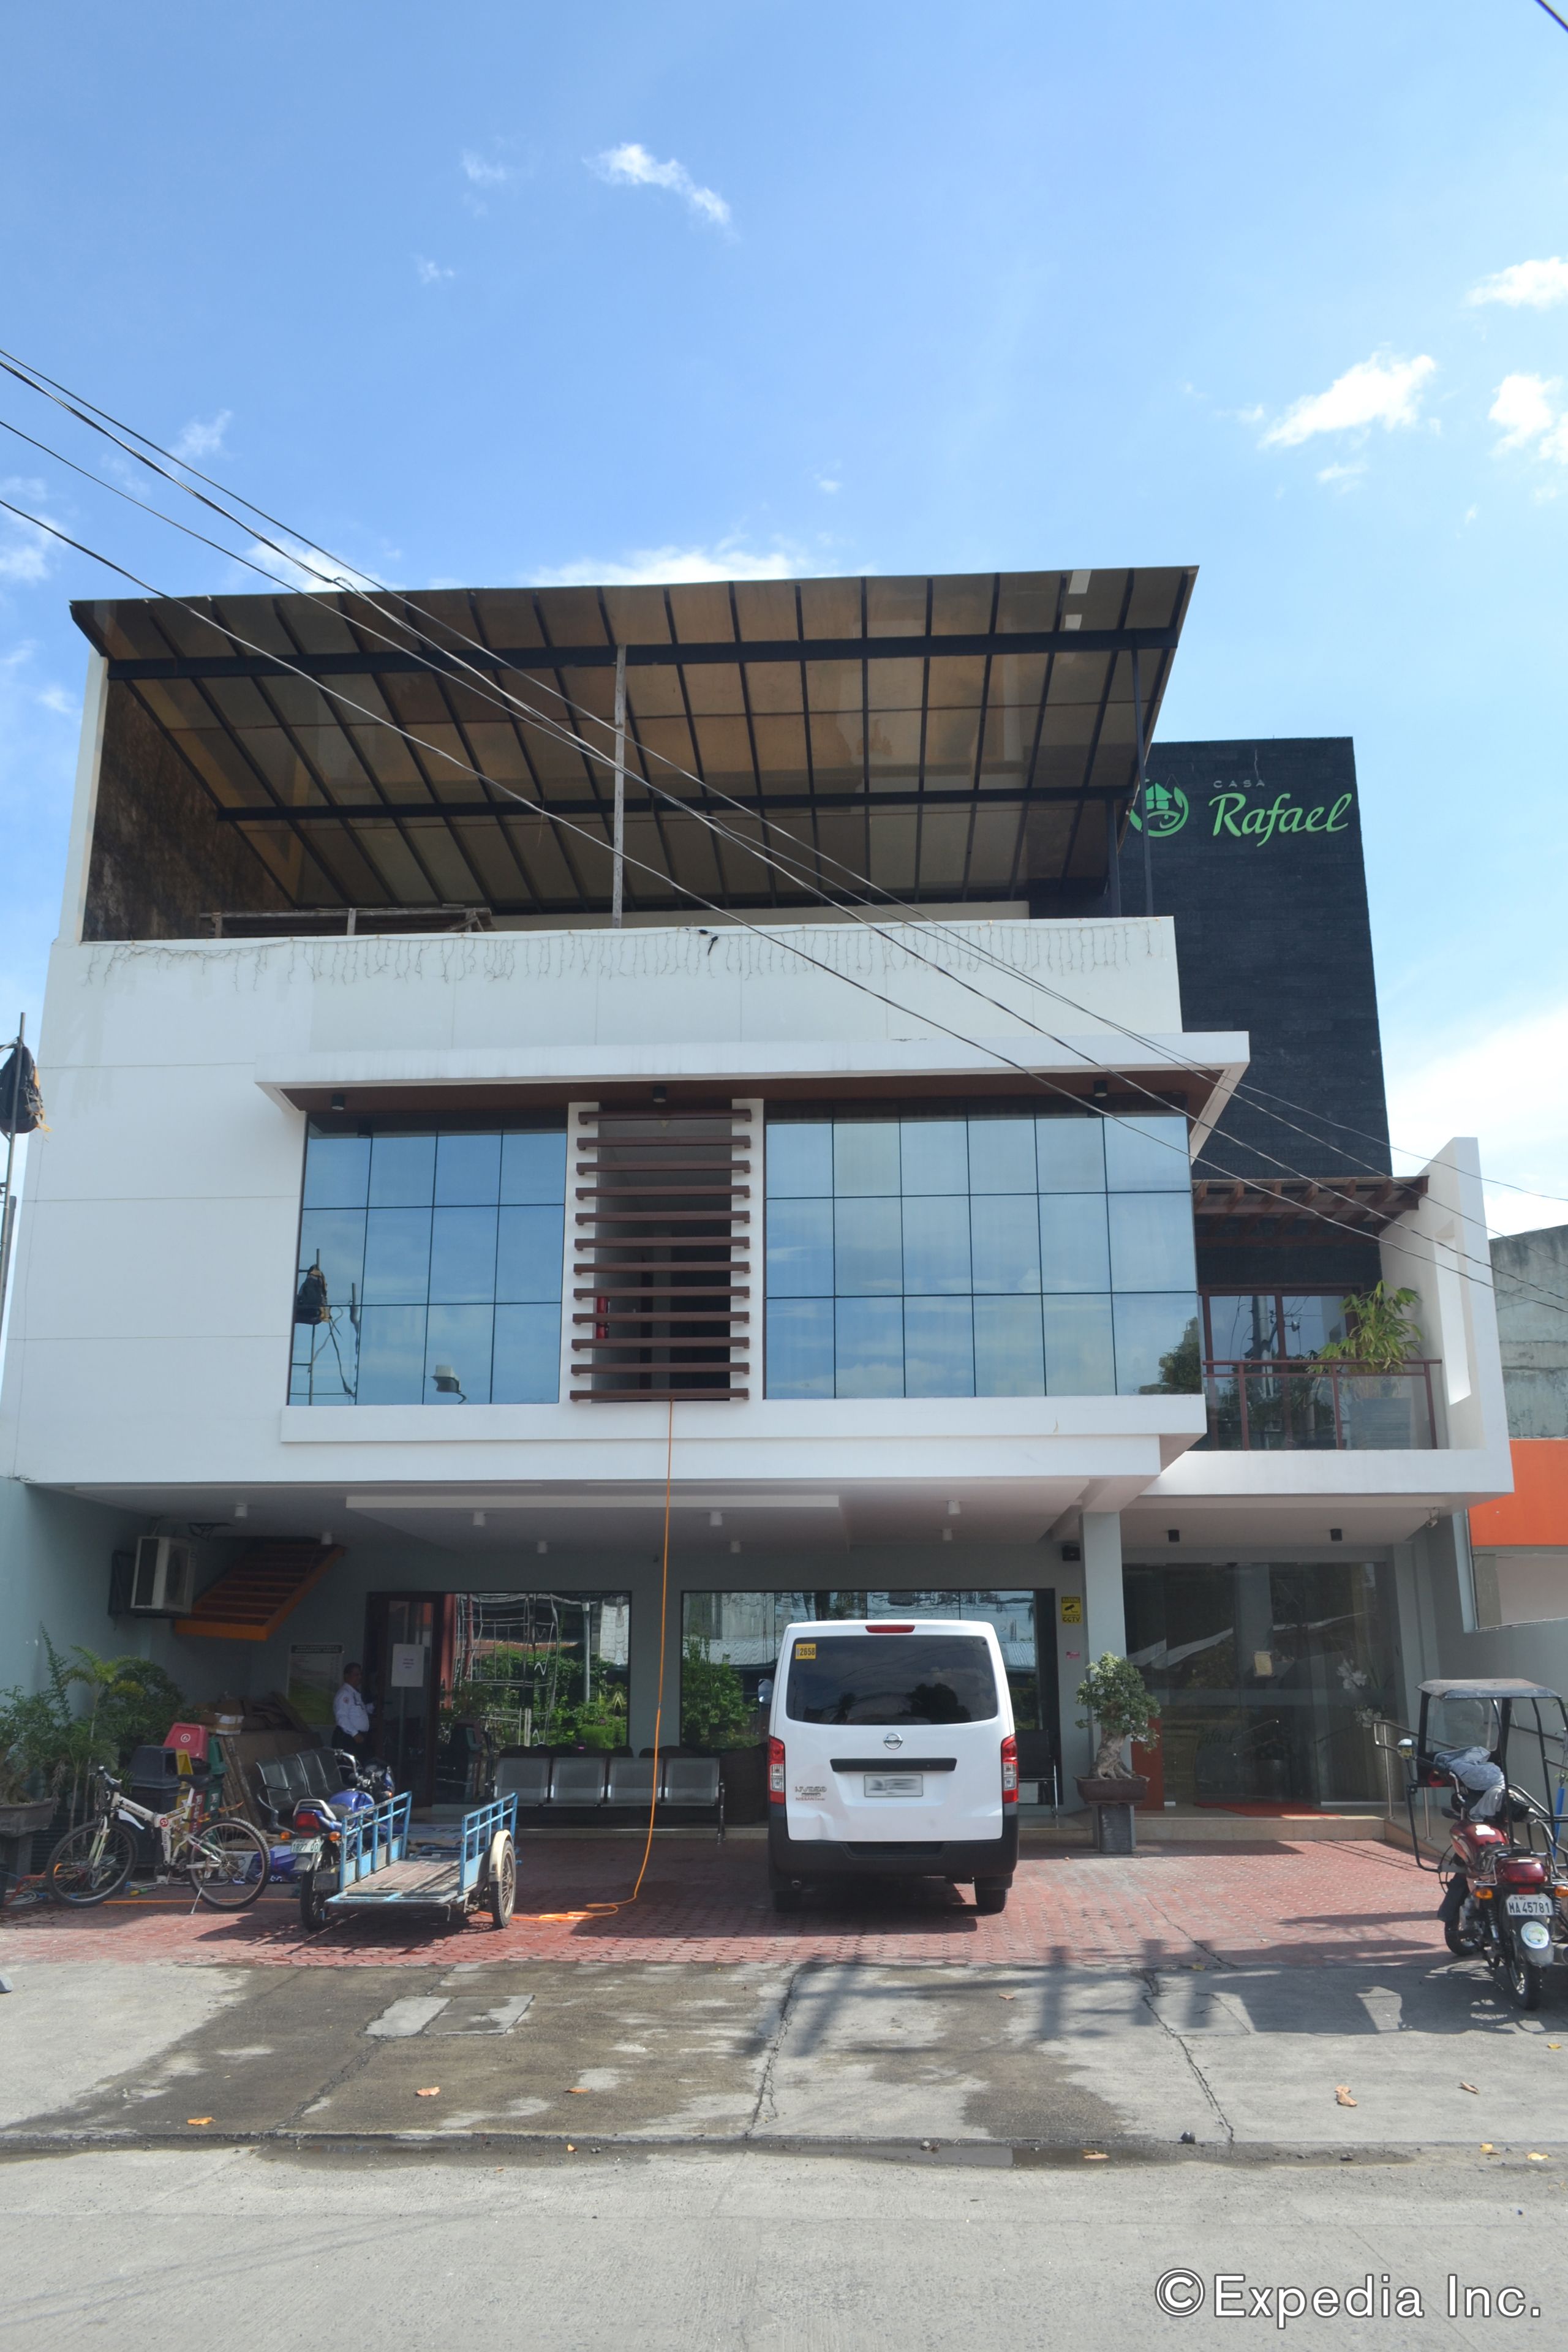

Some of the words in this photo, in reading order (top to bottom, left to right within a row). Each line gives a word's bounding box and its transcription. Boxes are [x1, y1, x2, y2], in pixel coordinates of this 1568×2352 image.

[1213, 779, 1265, 788] CASA
[1208, 793, 1352, 847] Rafael
[799, 1648, 815, 1656] 2658
[1522, 1902, 1550, 1913] 45781
